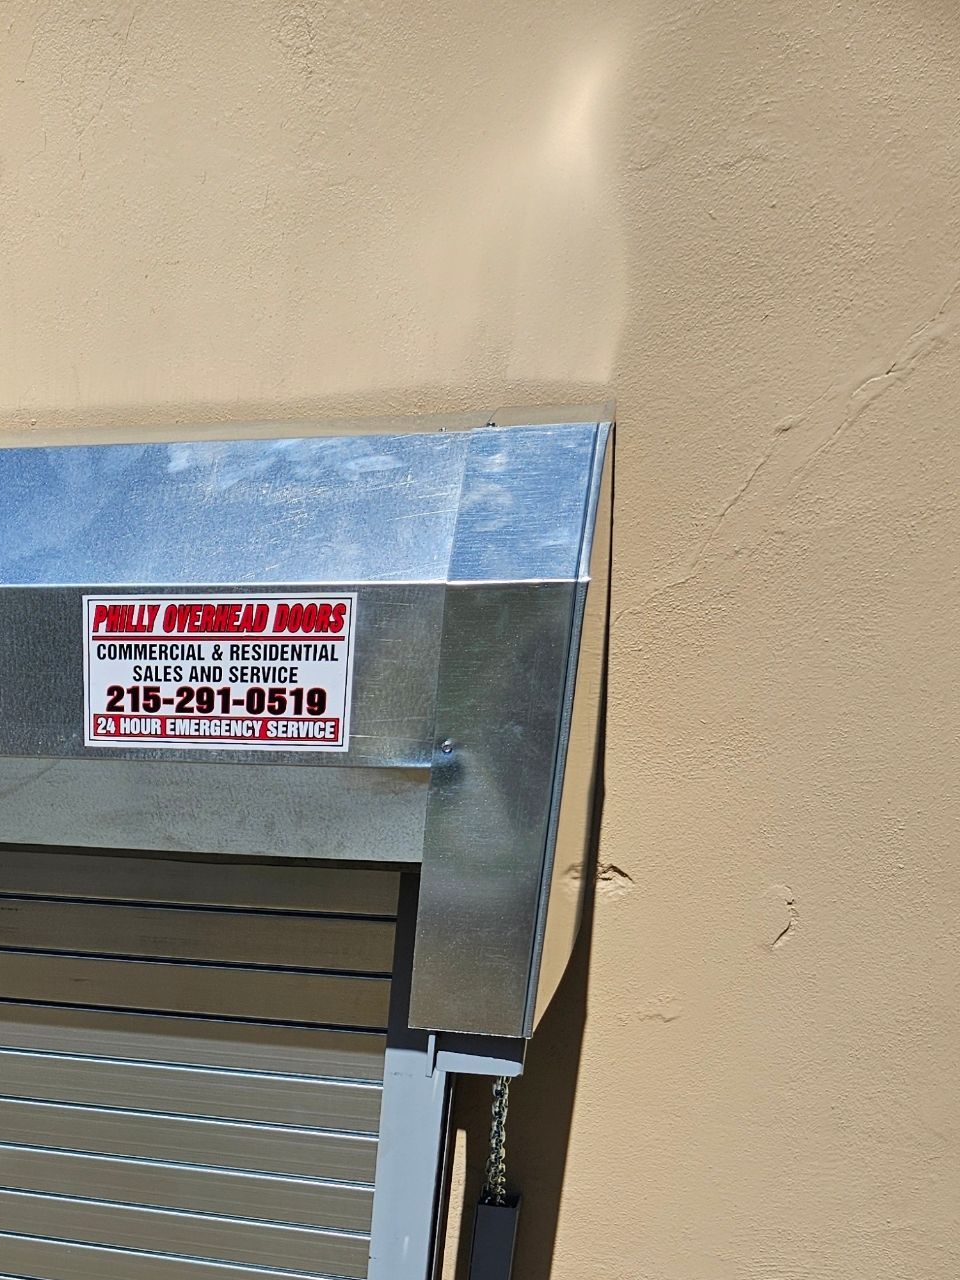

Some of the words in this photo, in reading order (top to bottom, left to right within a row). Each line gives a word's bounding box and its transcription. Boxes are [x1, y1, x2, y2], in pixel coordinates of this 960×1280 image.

[92, 604, 161, 633] PHILLY
[163, 603, 269, 633] OVERHEAD
[272, 603, 346, 633] DOORS
[97, 644, 205, 661] COMMERCIAL
[211, 644, 224, 661] &
[230, 644, 338, 662] RESIDENTIAL
[132, 666, 183, 682] SALES
[189, 666, 223, 683] AND
[229, 666, 298, 684] SERVICE
[106, 685, 327, 716] 215-291-0519
[97, 717, 116, 735] 24
[120, 717, 161, 736] HOUR
[166, 719, 262, 738] EMERGENCY
[267, 720, 335, 739] SERVICE
